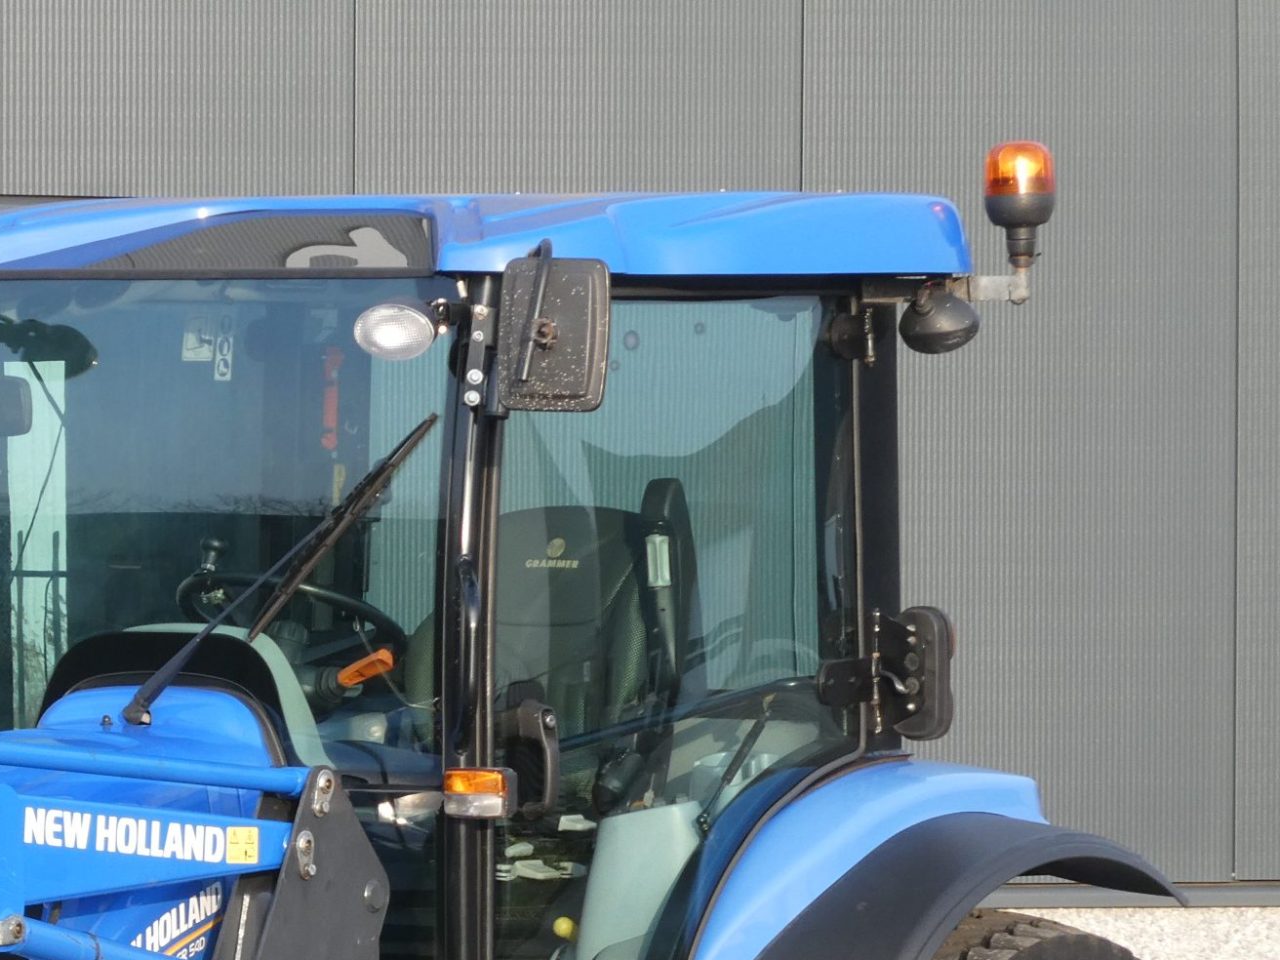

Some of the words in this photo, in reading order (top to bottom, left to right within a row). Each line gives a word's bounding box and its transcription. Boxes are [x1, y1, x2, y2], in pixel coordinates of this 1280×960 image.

[524, 559, 580, 569] GRAMMER
[23, 807, 92, 850] NEW
[95, 814, 227, 864] HOLLAND
[145, 881, 221, 953] HOLLAND
